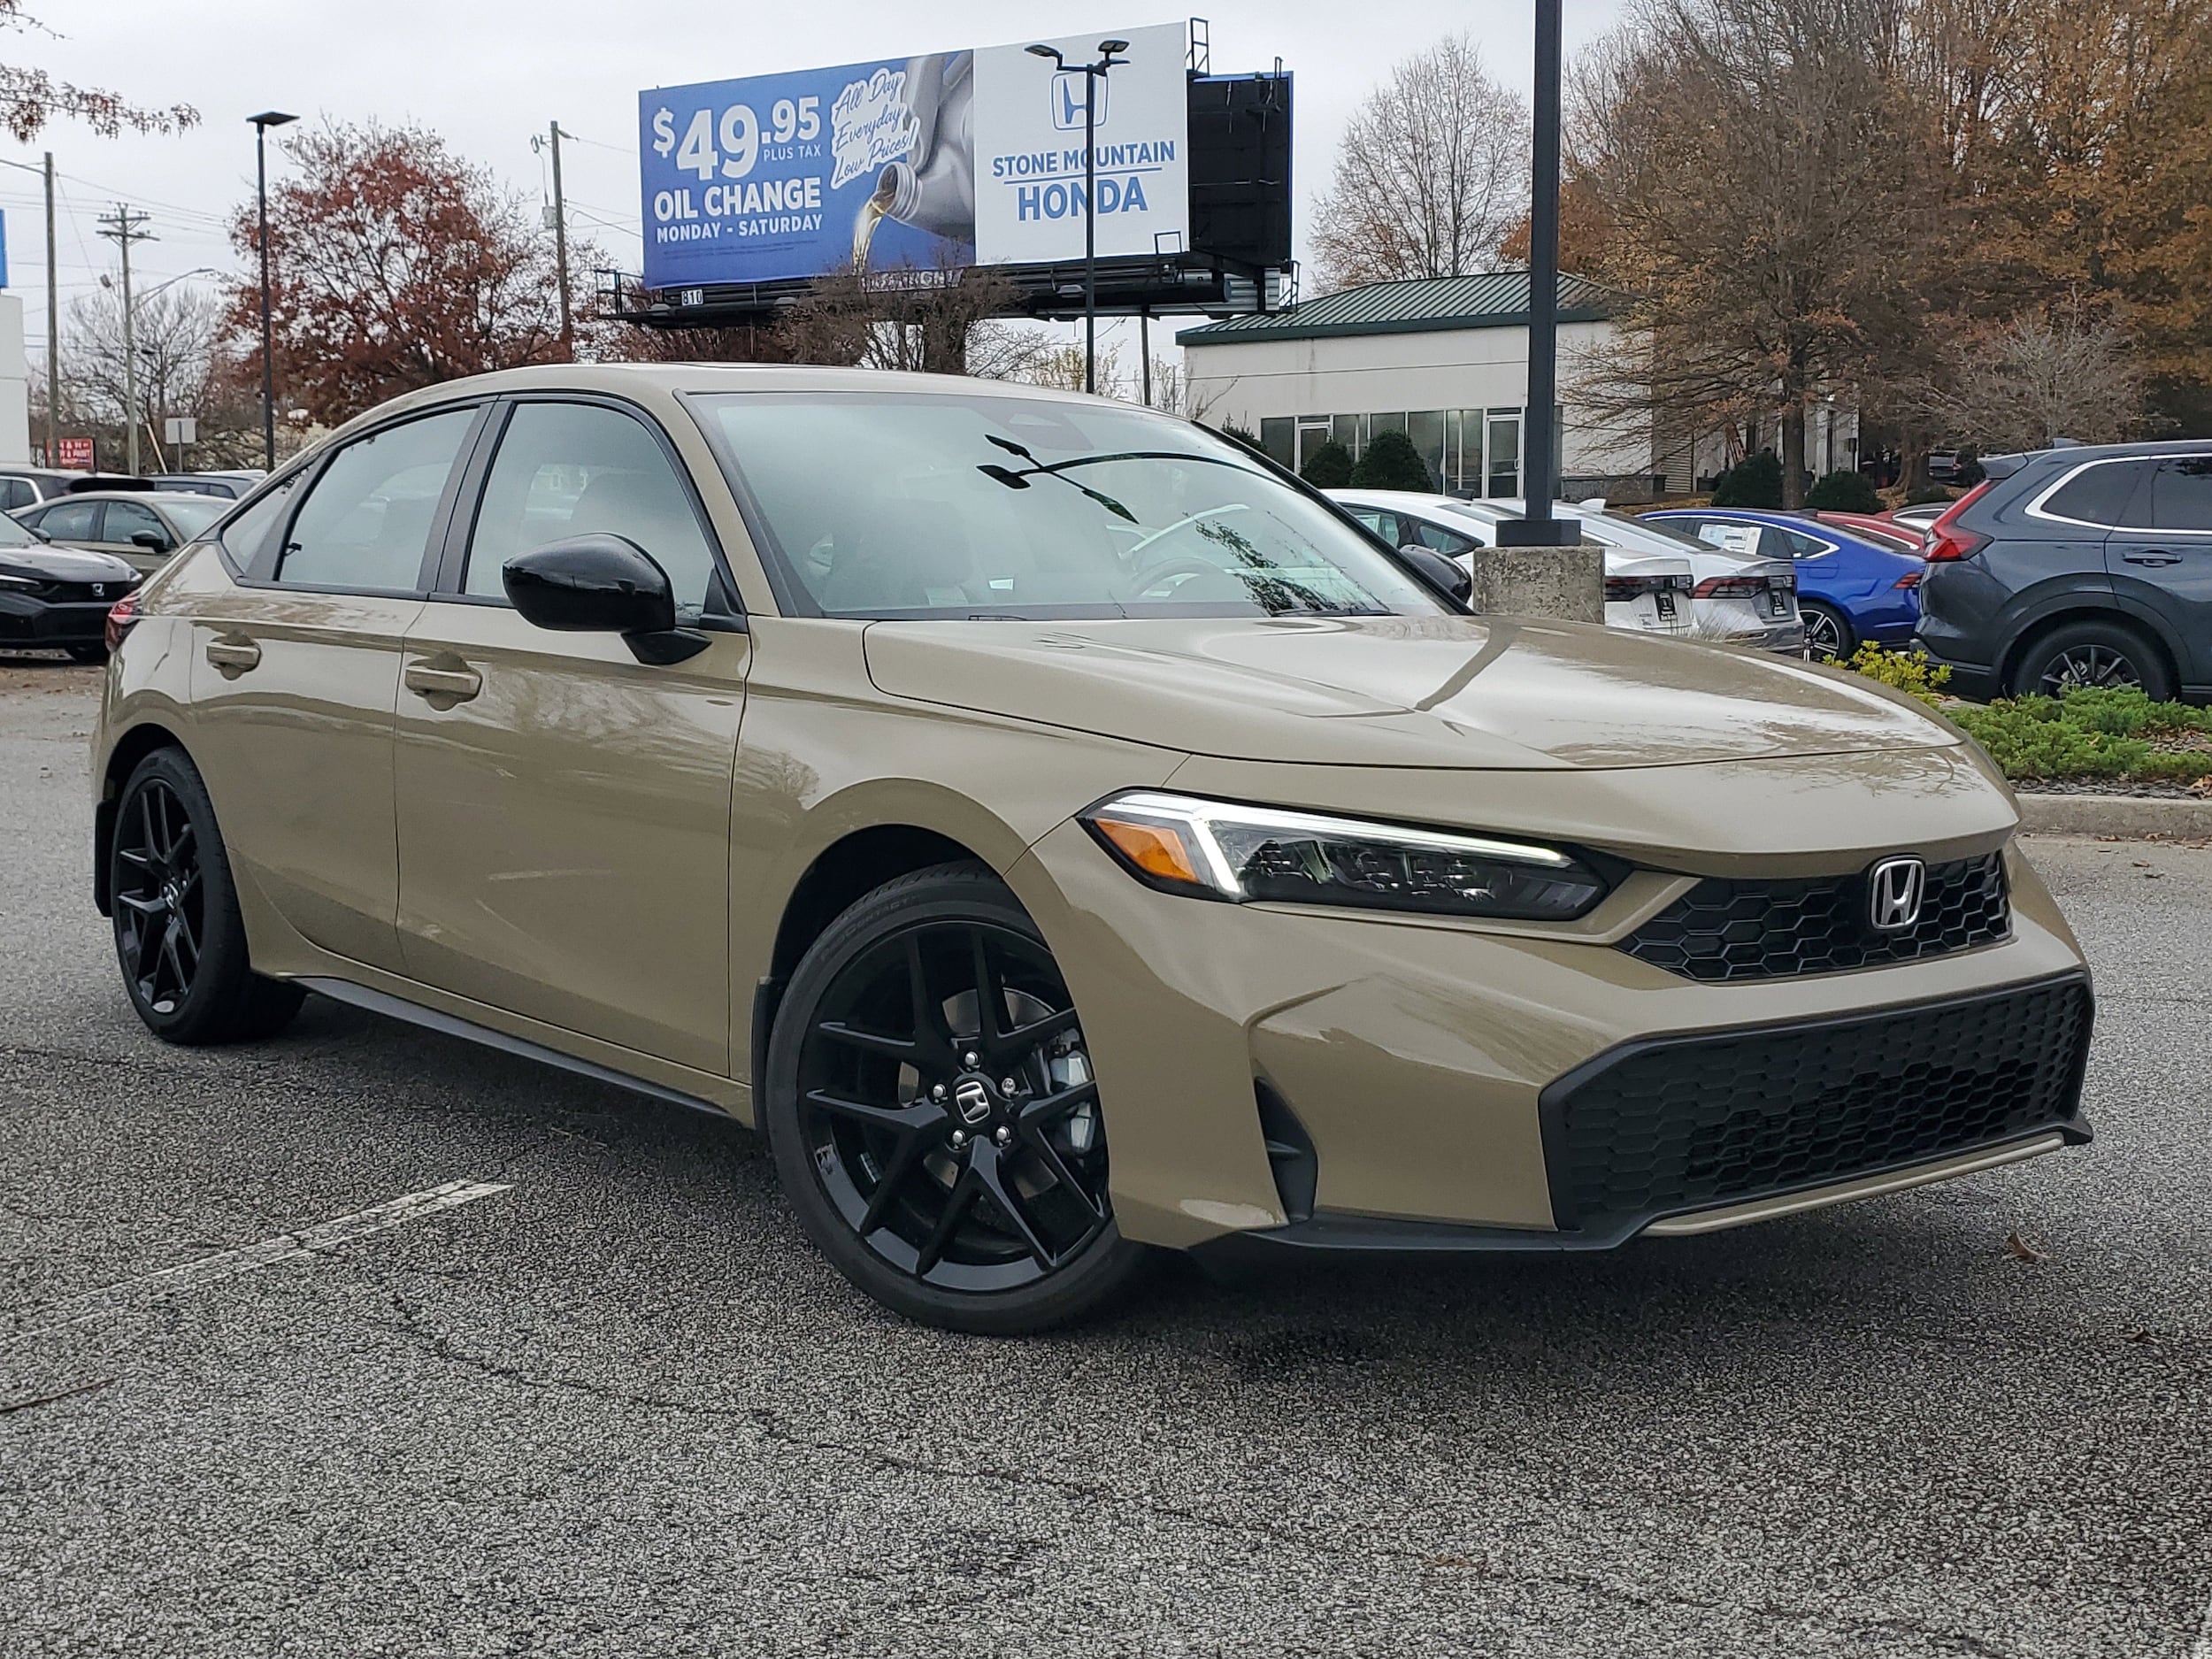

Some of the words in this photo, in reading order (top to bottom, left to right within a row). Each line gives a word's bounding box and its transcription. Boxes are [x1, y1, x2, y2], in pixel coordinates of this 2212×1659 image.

[834, 85, 864, 122] All
[869, 73, 902, 103] Day
[835, 104, 902, 152] Everyday
[763, 147, 794, 162] PLUS
[798, 143, 822, 159] TAX
[834, 155, 865, 185] Low
[867, 120, 918, 167] Prices!
[992, 151, 1058, 178] STONE
[654, 188, 699, 222] OIL
[704, 176, 822, 217] CHANGE
[1018, 176, 1148, 221] HONDA
[657, 222, 721, 244] MONDAY
[738, 213, 823, 236] SATURDAY
[682, 289, 703, 305] 810
